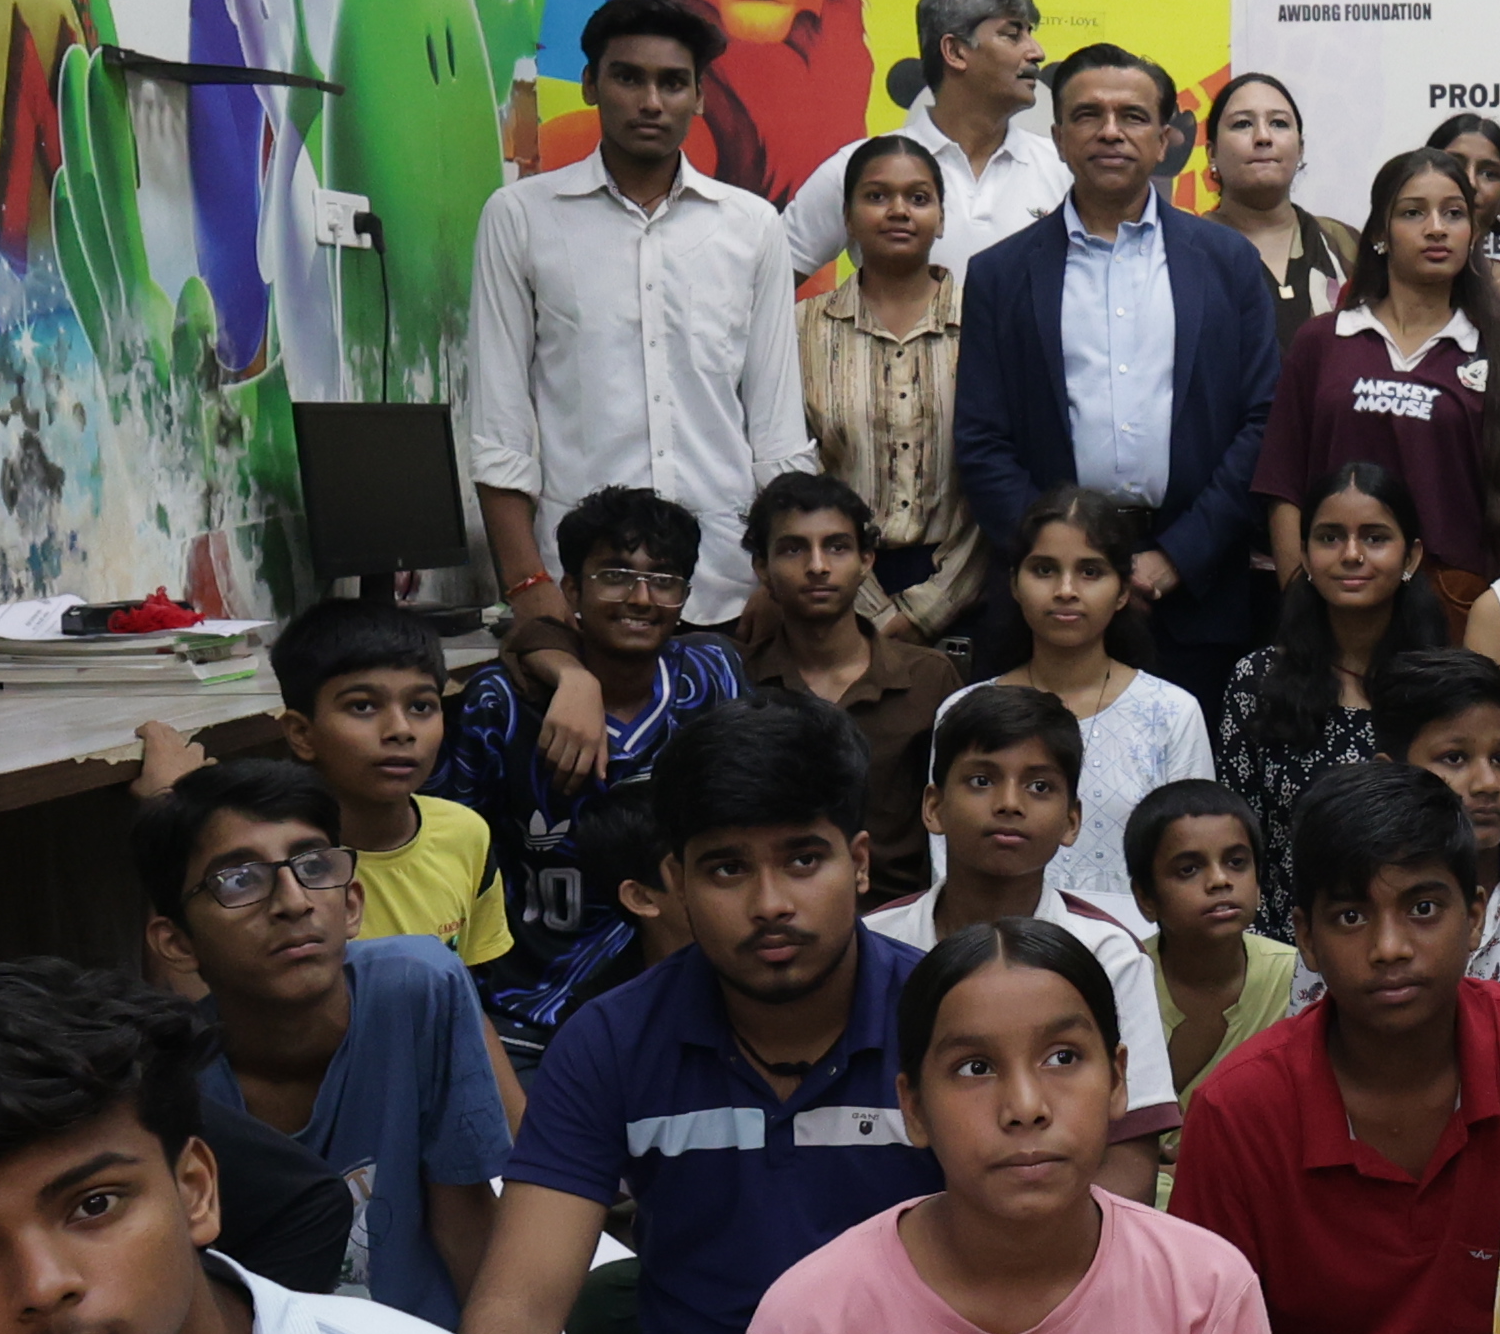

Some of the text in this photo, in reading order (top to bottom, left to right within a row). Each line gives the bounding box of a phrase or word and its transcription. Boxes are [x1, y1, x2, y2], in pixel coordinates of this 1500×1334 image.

[1278, 3, 1432, 22] AWDORG FOUNDATION
[1352, 377, 1441, 401] MICKEY
[1353, 396, 1432, 421] MOUSE
